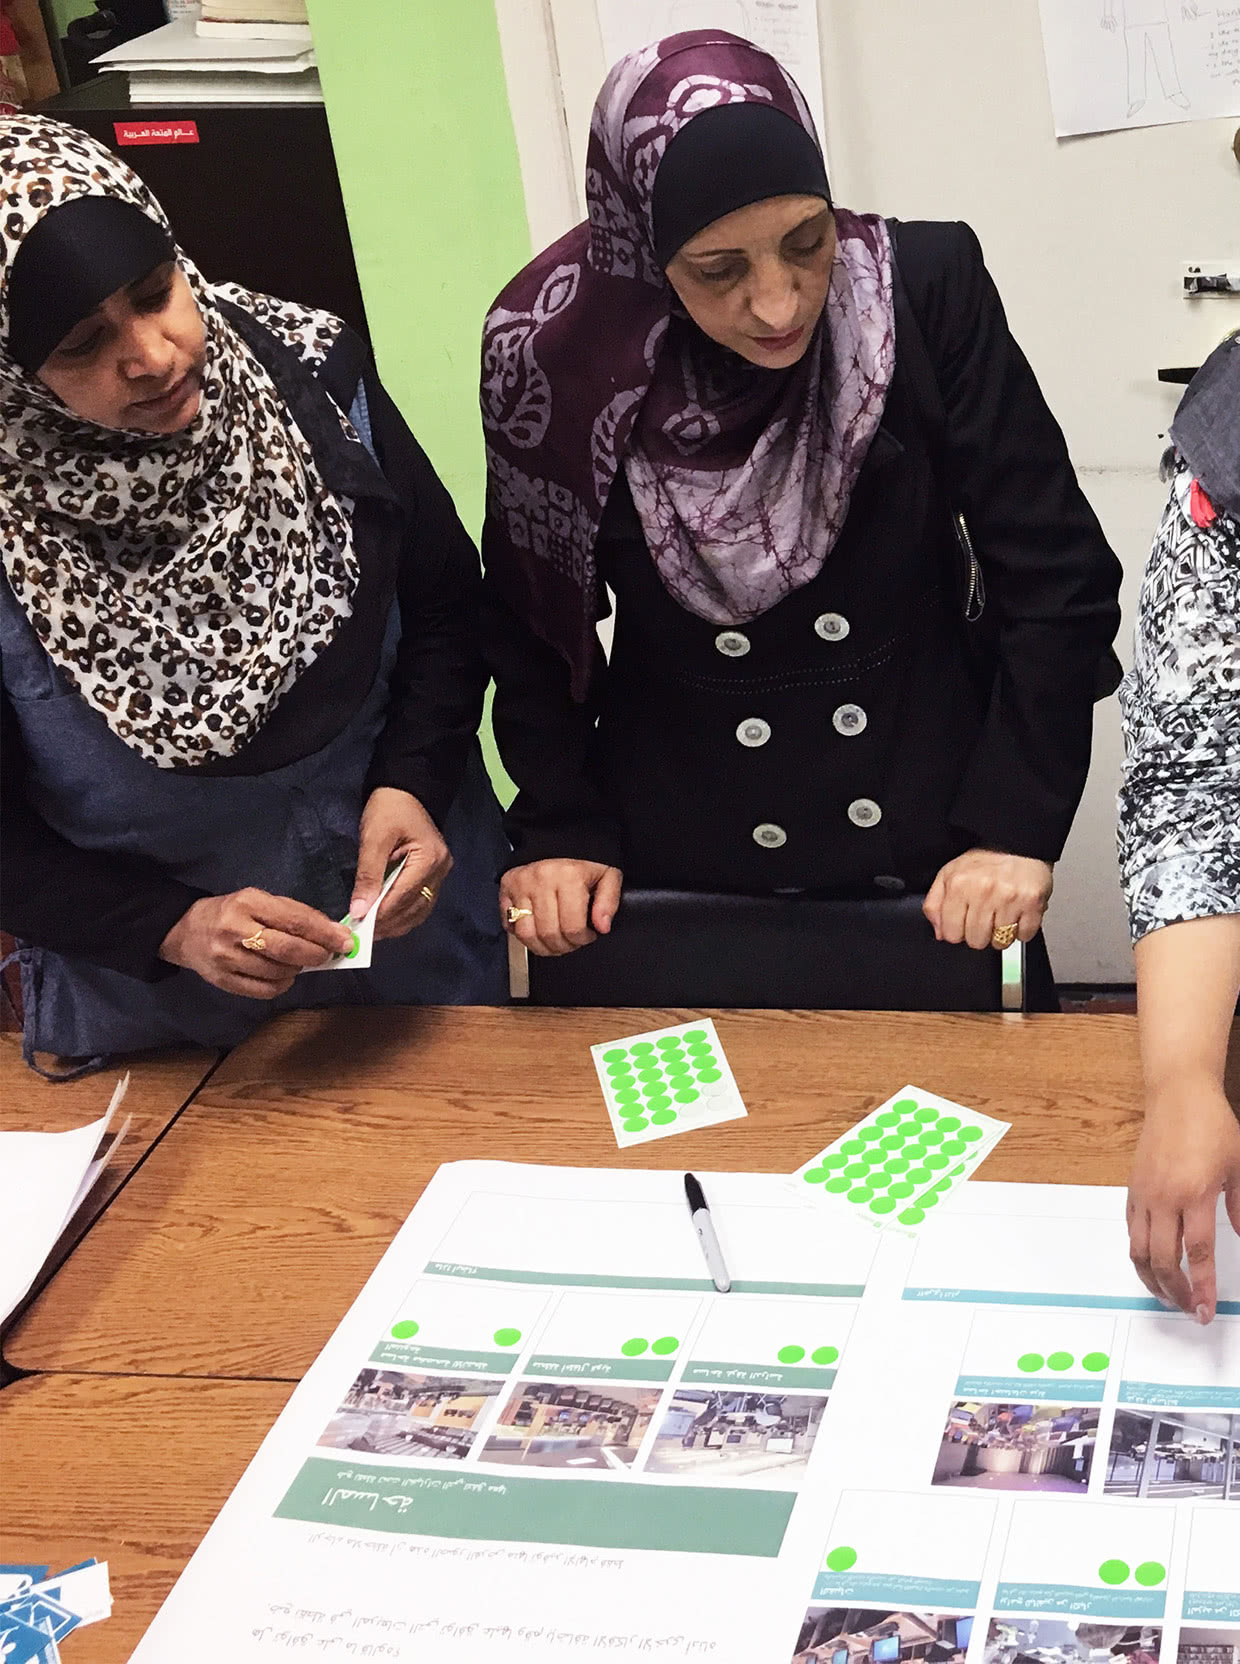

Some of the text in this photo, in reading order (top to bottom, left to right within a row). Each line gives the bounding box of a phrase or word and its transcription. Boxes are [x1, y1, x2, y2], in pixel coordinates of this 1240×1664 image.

[692, 1368, 723, 1378] مساحة
[748, 1370, 782, 1382] الدراسة
[320, 1488, 414, 1514] المساحة
[409, 1618, 439, 1634] التي
